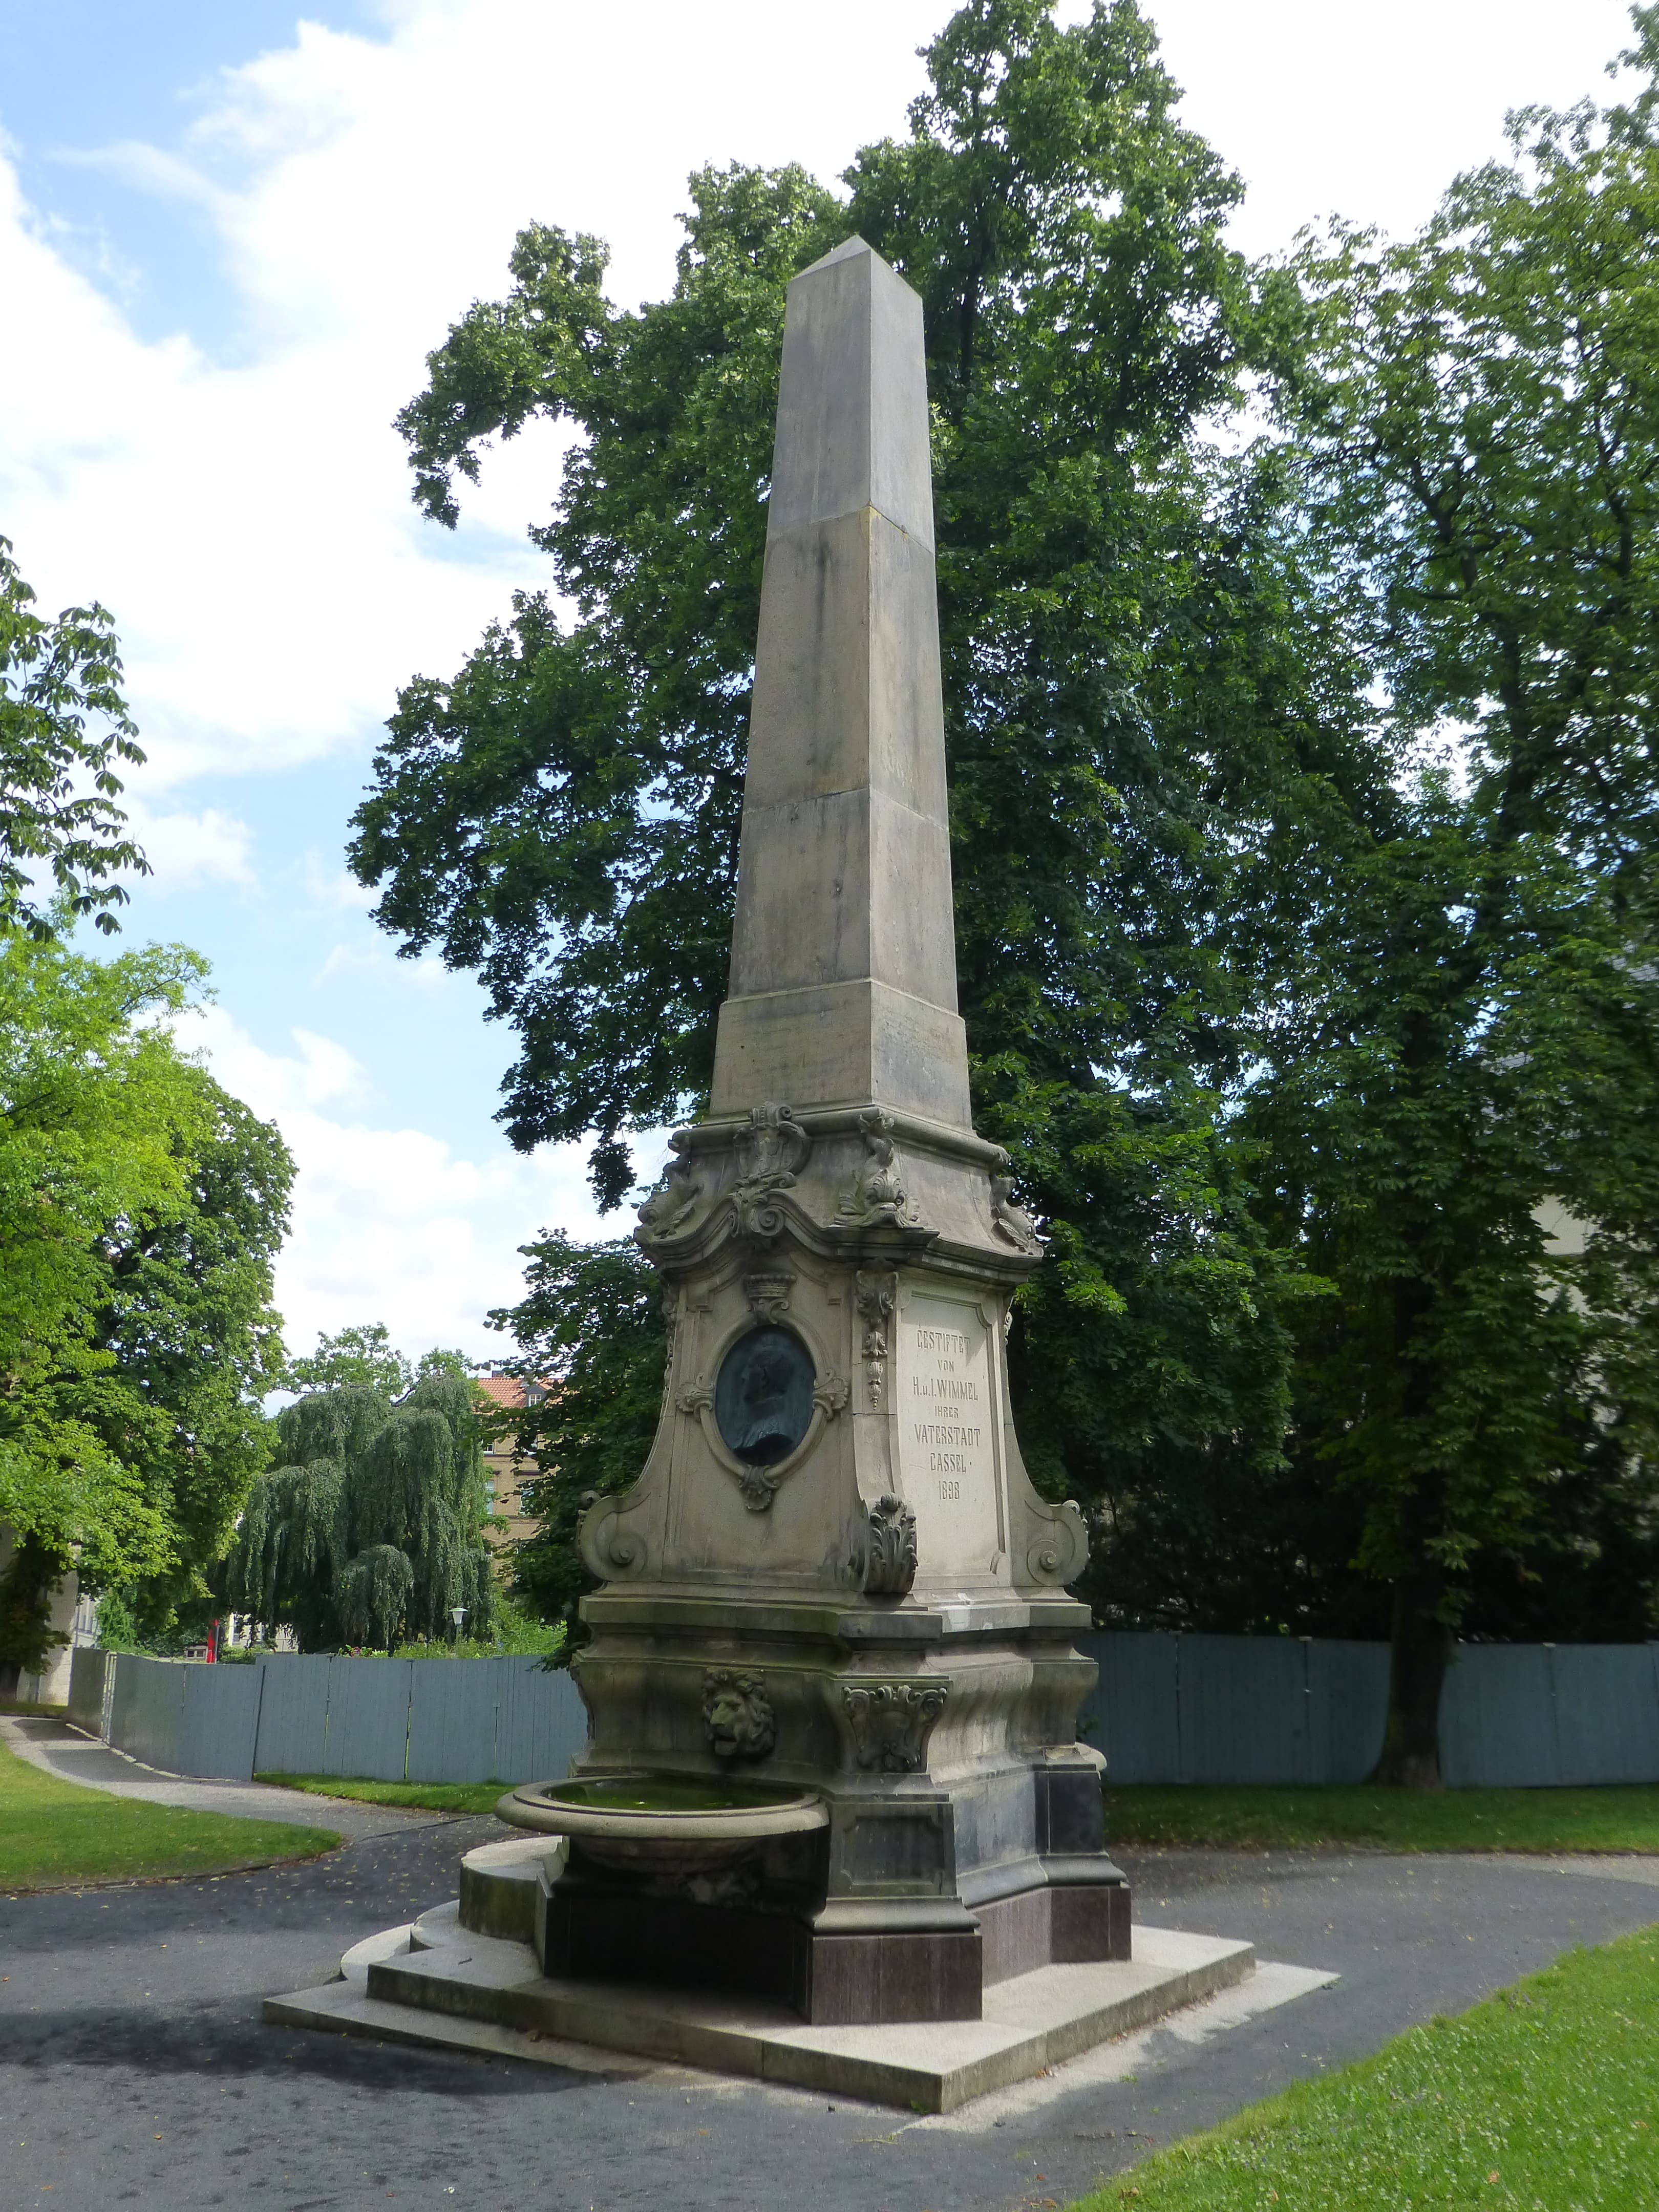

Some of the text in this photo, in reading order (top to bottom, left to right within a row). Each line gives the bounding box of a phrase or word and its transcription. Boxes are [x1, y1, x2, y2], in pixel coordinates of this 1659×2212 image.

[917, 1330, 970, 1354] GESTIFTET
[938, 1359, 954, 1372] VON
[935, 1406, 959, 1418] IHRER
[914, 1424, 980, 1446] VATERSTADT
[930, 1453, 966, 1473] CASSEL
[939, 1480, 960, 1499] 1898
